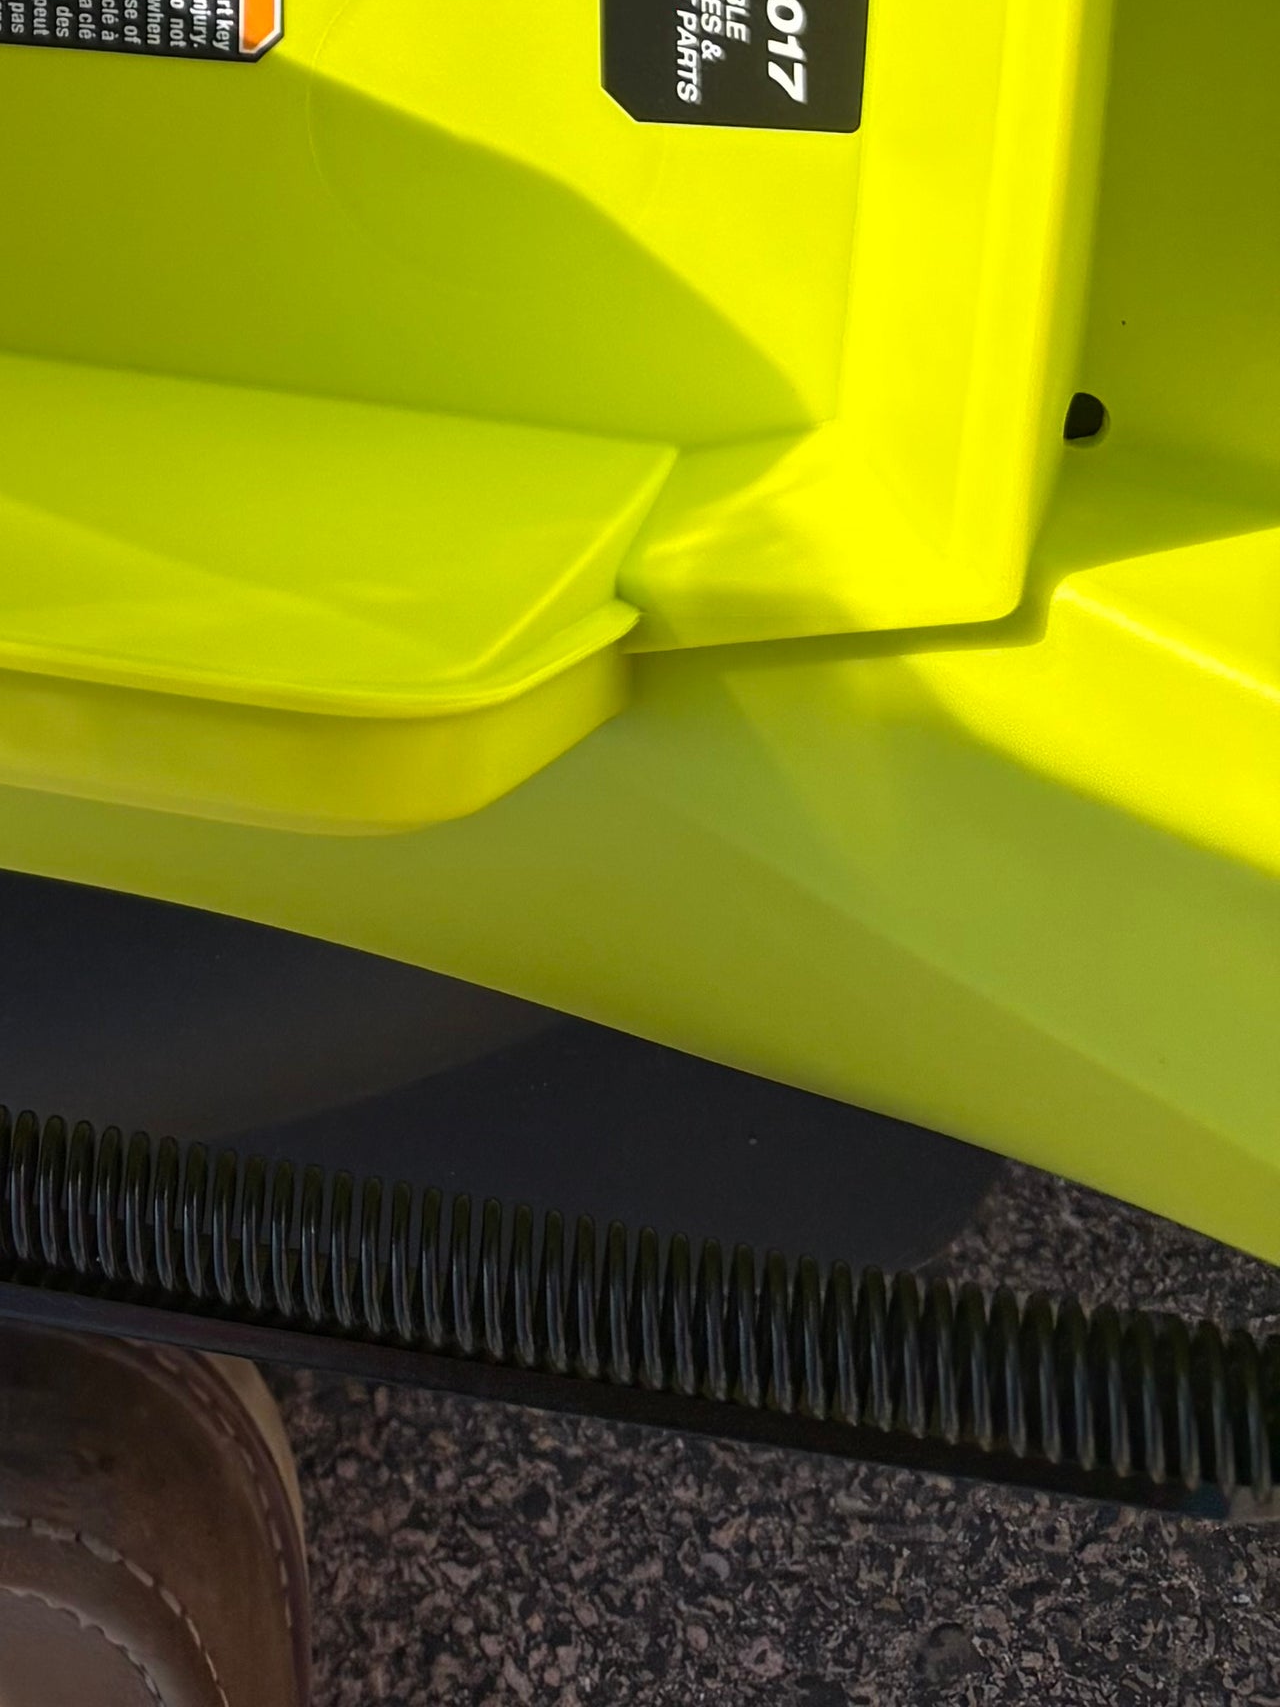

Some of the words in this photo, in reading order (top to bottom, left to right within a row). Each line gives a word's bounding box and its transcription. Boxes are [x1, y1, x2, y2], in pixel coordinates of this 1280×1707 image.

[123, 24, 141, 43] of
[169, 17, 186, 47] not
[212, 18, 233, 51] key
[676, 9, 699, 105] PARTS
[701, 40, 721, 61] &
